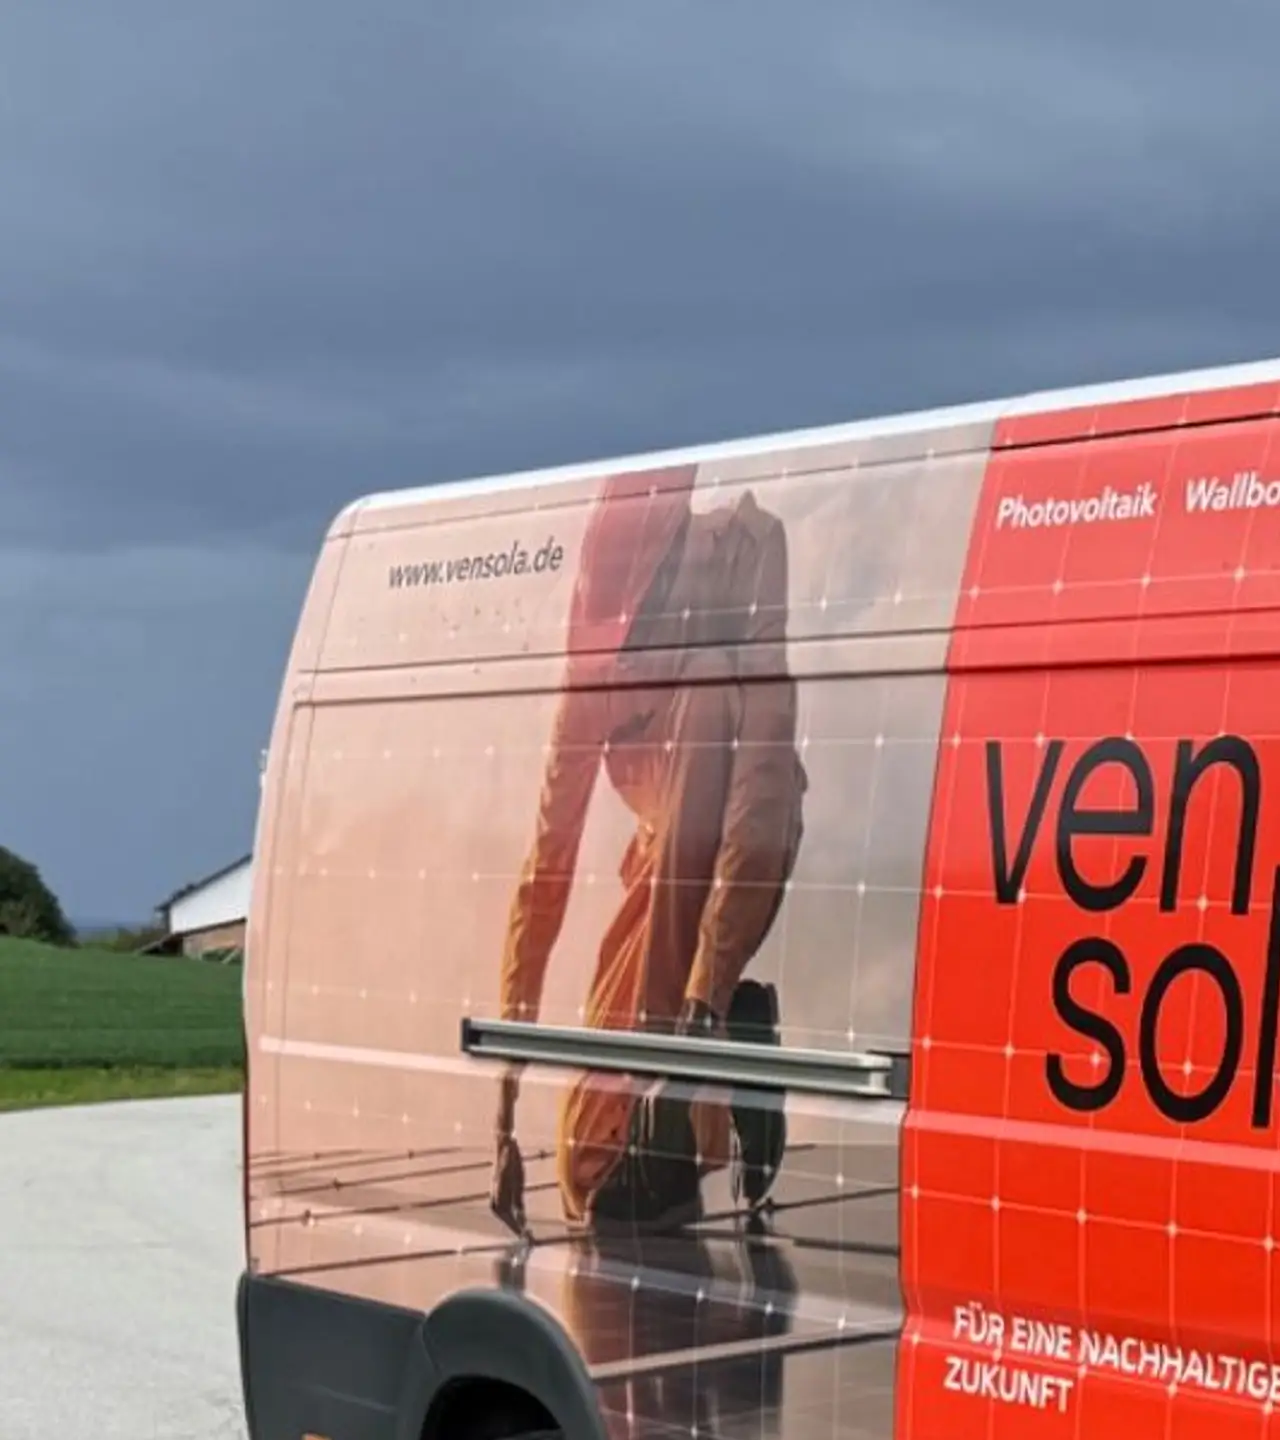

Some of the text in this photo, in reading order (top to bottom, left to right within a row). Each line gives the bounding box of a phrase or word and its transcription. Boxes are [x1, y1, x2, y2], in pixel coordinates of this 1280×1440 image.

[995, 483, 1158, 529] Photovoltaik
[388, 535, 564, 588] www.vensola.de
[984, 735, 1262, 916] ven
[952, 1301, 1004, 1346] FÜR
[1010, 1317, 1072, 1360] EINE
[943, 1357, 1074, 1413] ZUKUNFT
